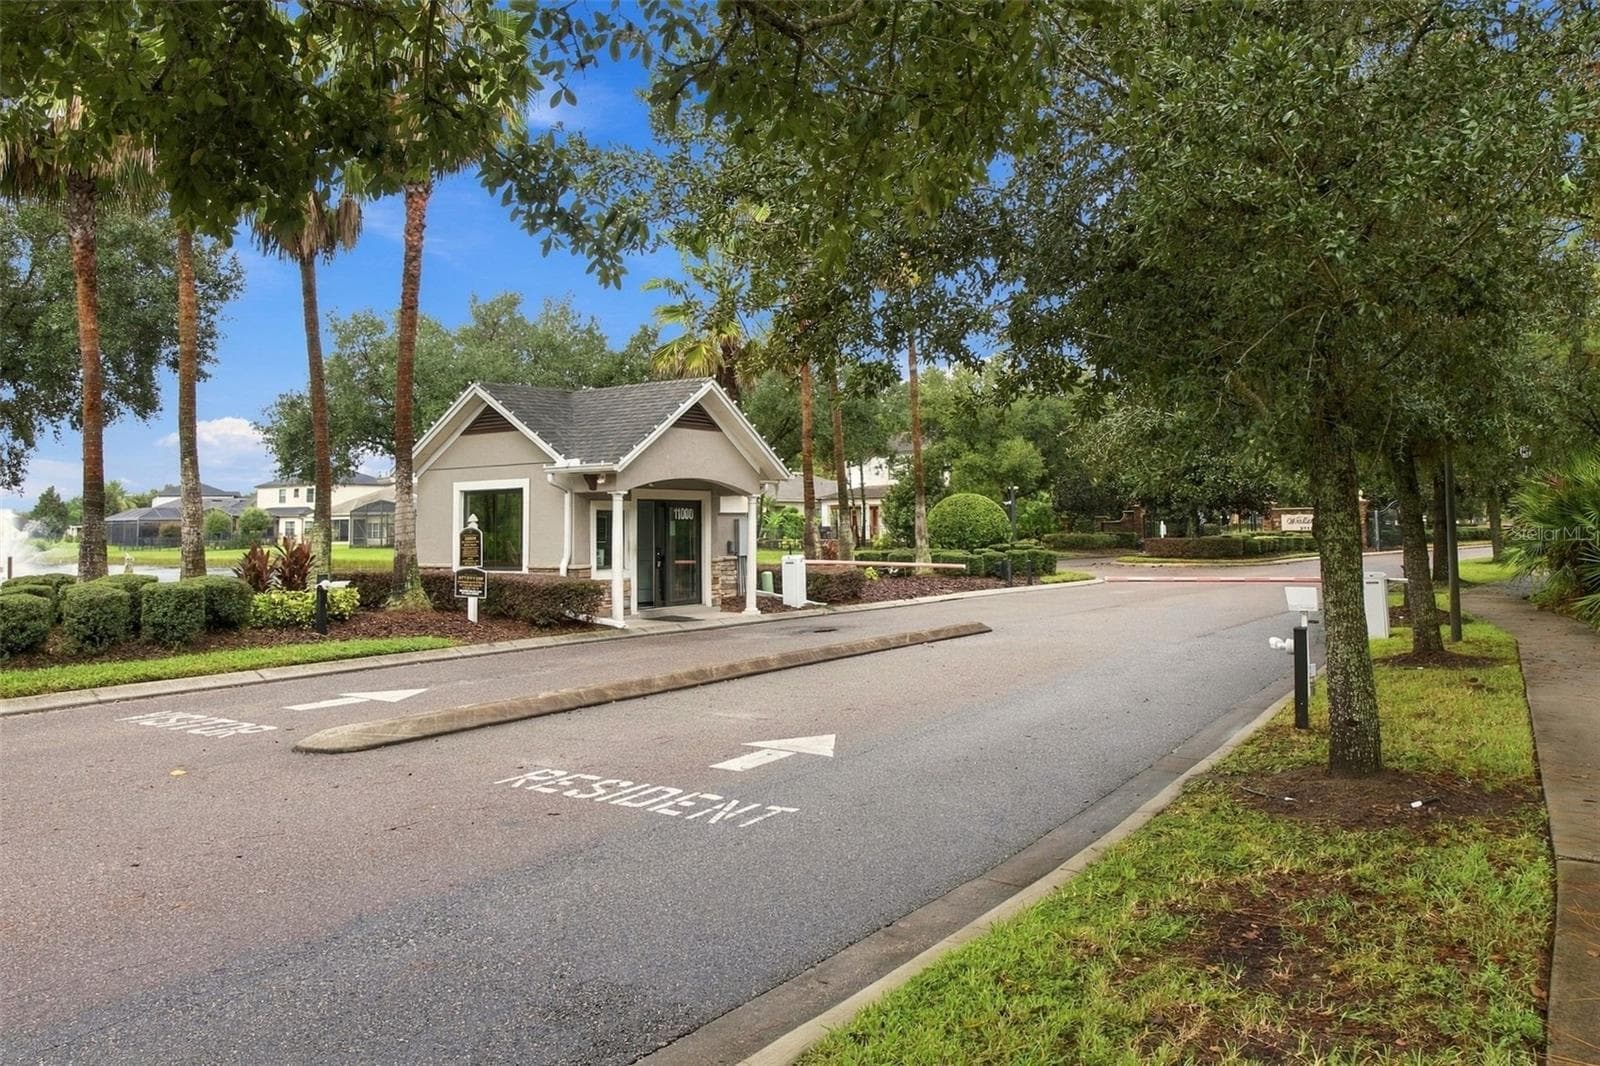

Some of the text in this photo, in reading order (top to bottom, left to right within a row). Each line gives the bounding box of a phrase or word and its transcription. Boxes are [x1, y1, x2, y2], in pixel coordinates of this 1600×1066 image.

[673, 507, 694, 520] 11000
[115, 710, 278, 738] VISITOR
[494, 769, 800, 827] RESIDENT
